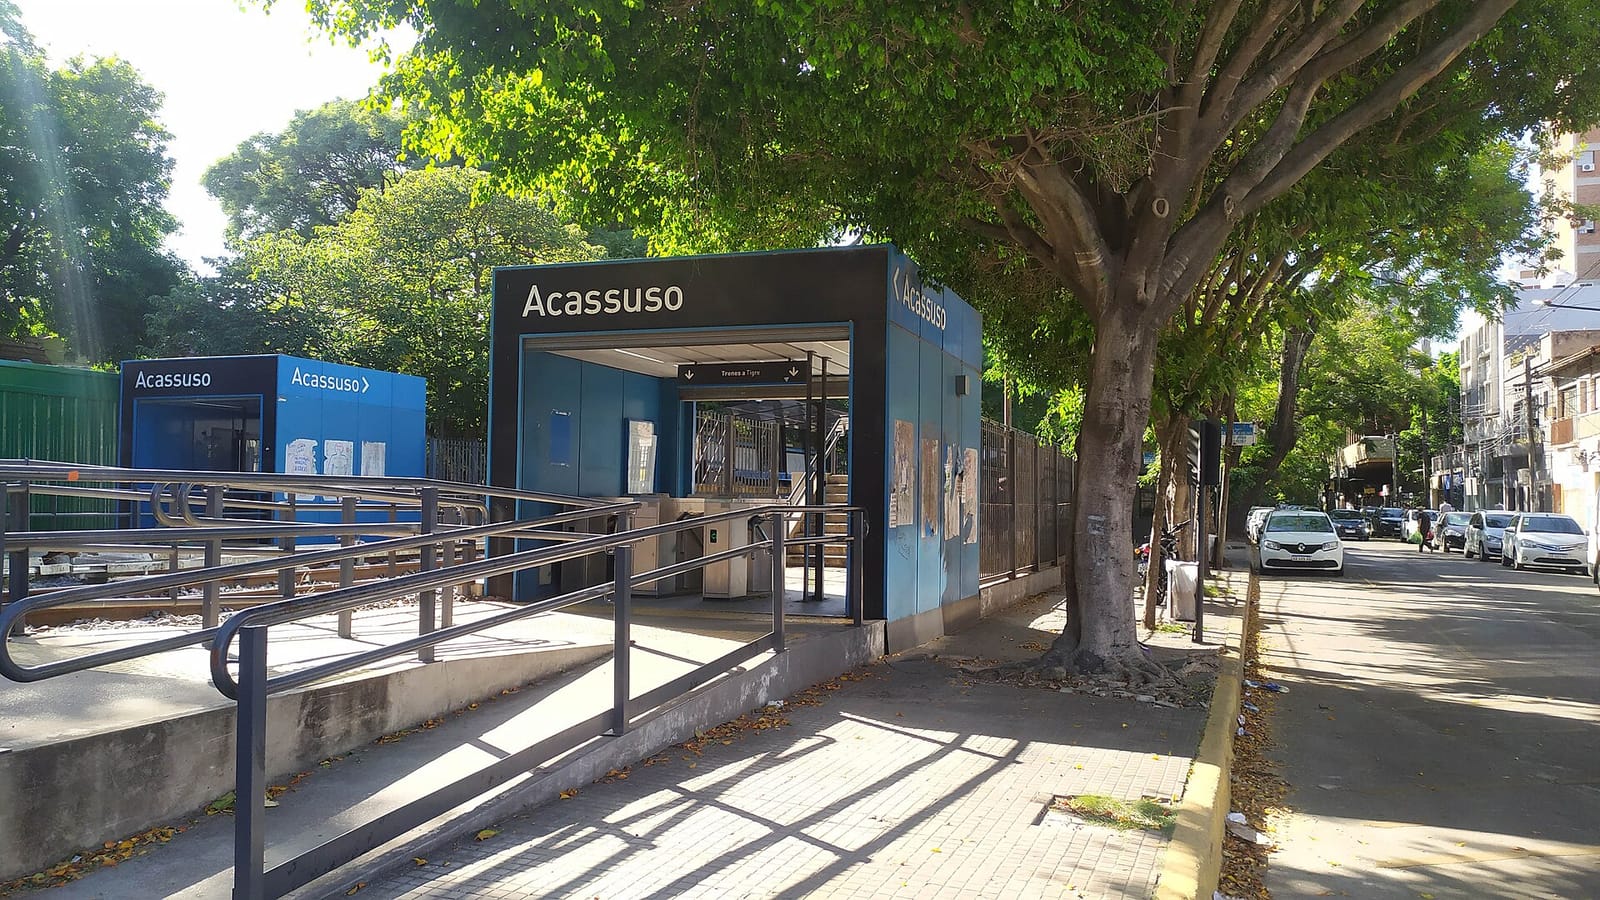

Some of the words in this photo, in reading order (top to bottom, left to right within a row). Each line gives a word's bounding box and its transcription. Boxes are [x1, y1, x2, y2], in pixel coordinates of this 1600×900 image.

[521, 284, 684, 318] Acassuso
[902, 273, 947, 331] Acassuso
[135, 370, 211, 389] Acassuso
[291, 366, 360, 393] Acassuso
[746, 369, 760, 377] Tigre
